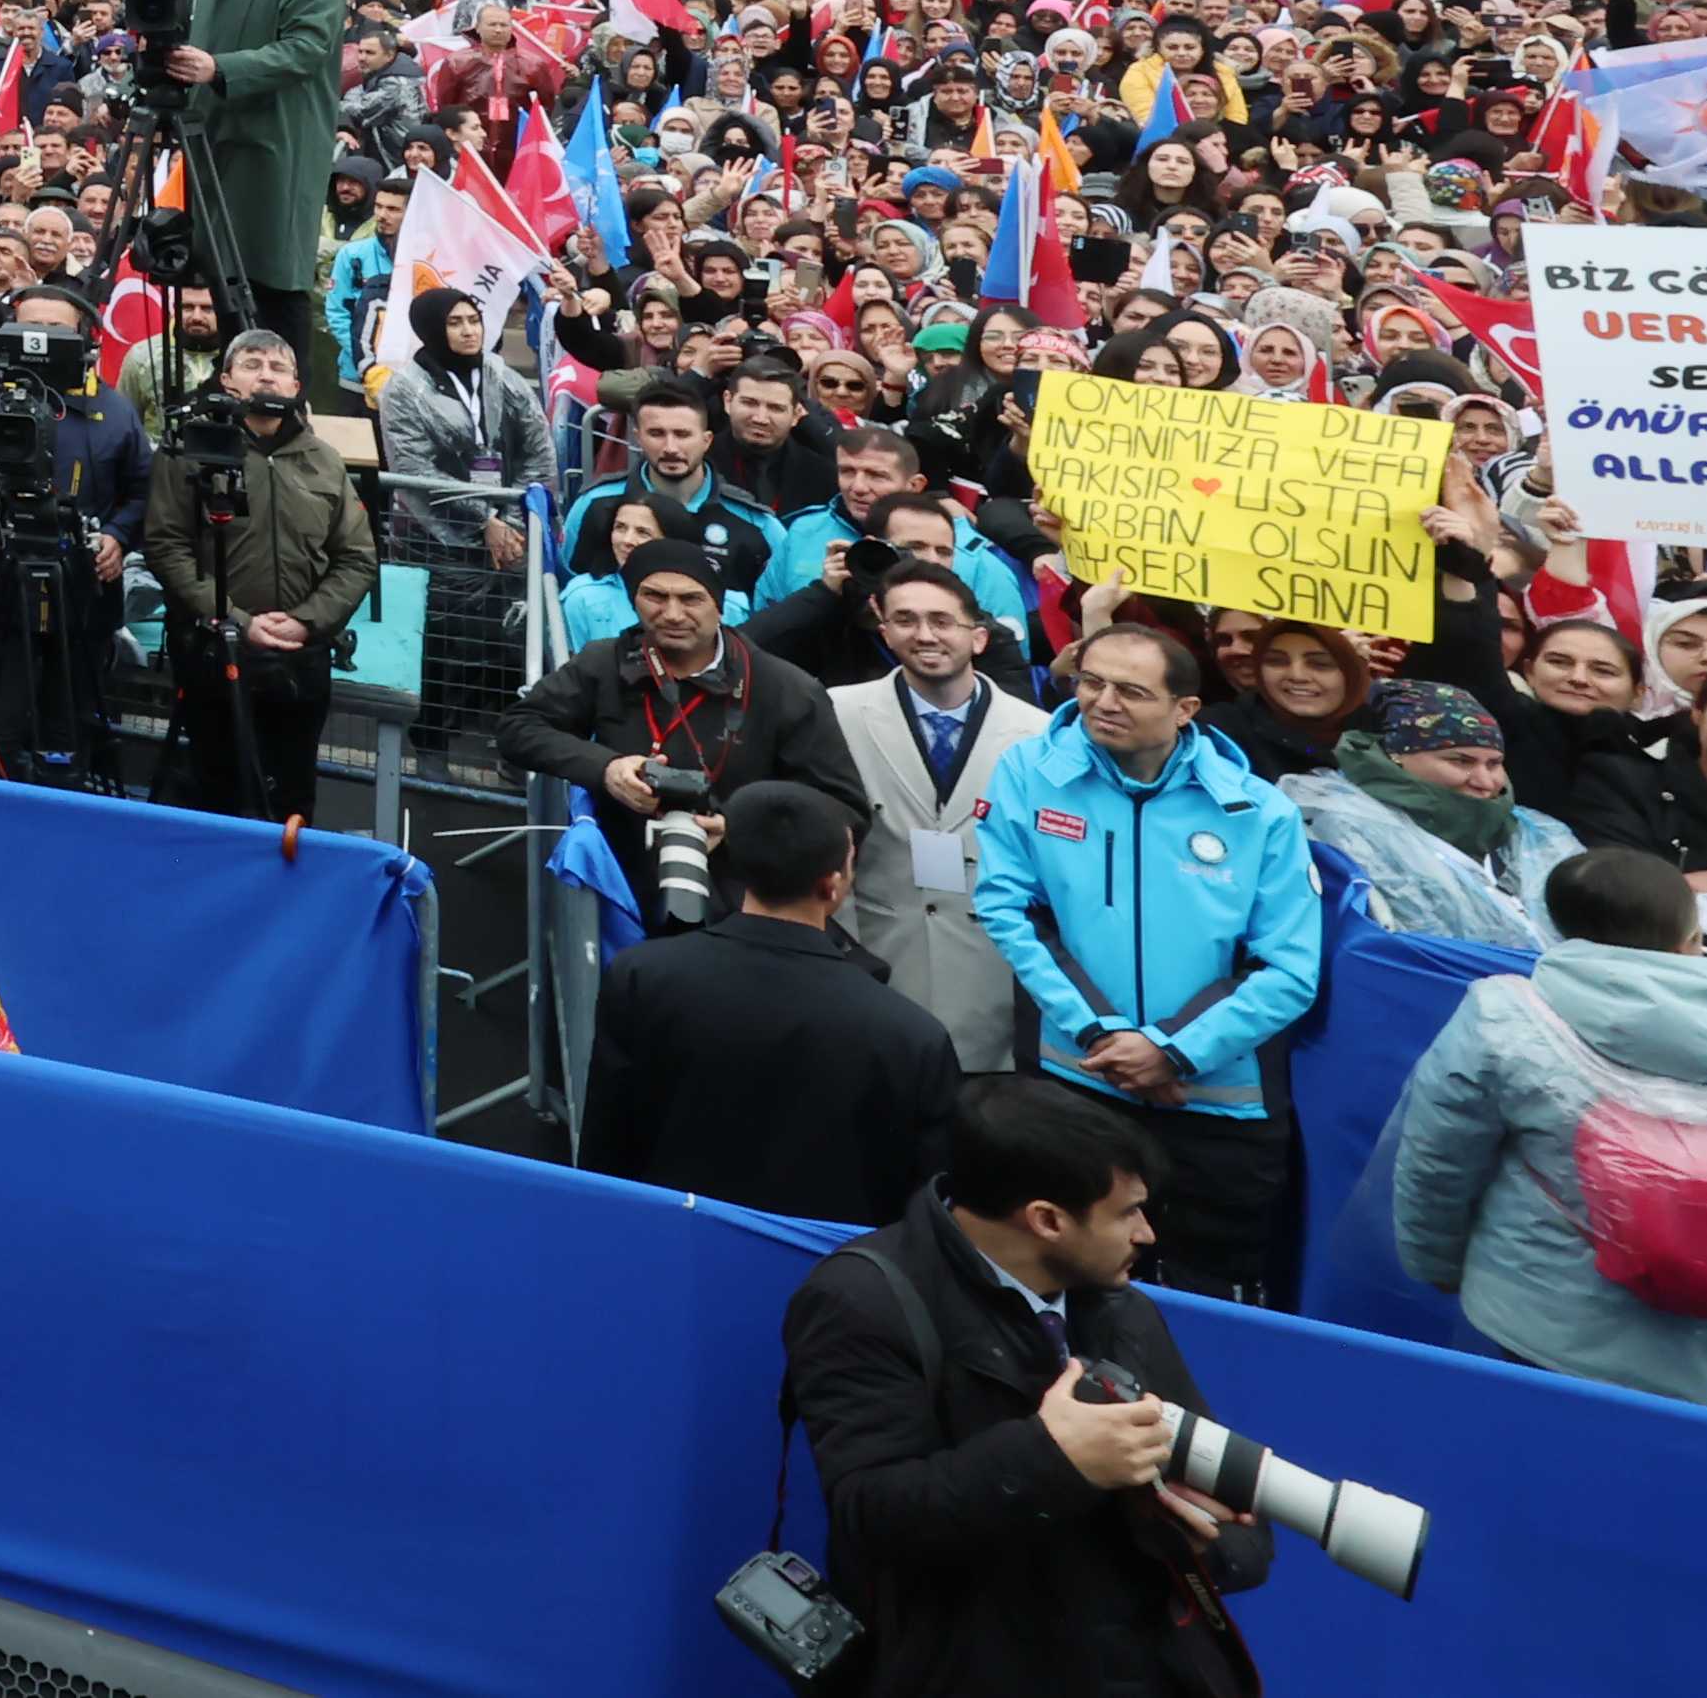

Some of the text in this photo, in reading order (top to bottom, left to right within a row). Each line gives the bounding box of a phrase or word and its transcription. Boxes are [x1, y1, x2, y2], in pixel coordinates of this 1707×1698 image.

[1544, 260, 1635, 292] BİZ
[29, 337, 42, 351] 3
[1065, 374, 1423, 452] ÖMRÜNE DUA
[1044, 410, 1429, 490] İNSANIMIZA VEFA
[1235, 478, 1392, 534] USTA
[1249, 520, 1421, 584] OLSUN
[1252, 565, 1390, 631] SANA
